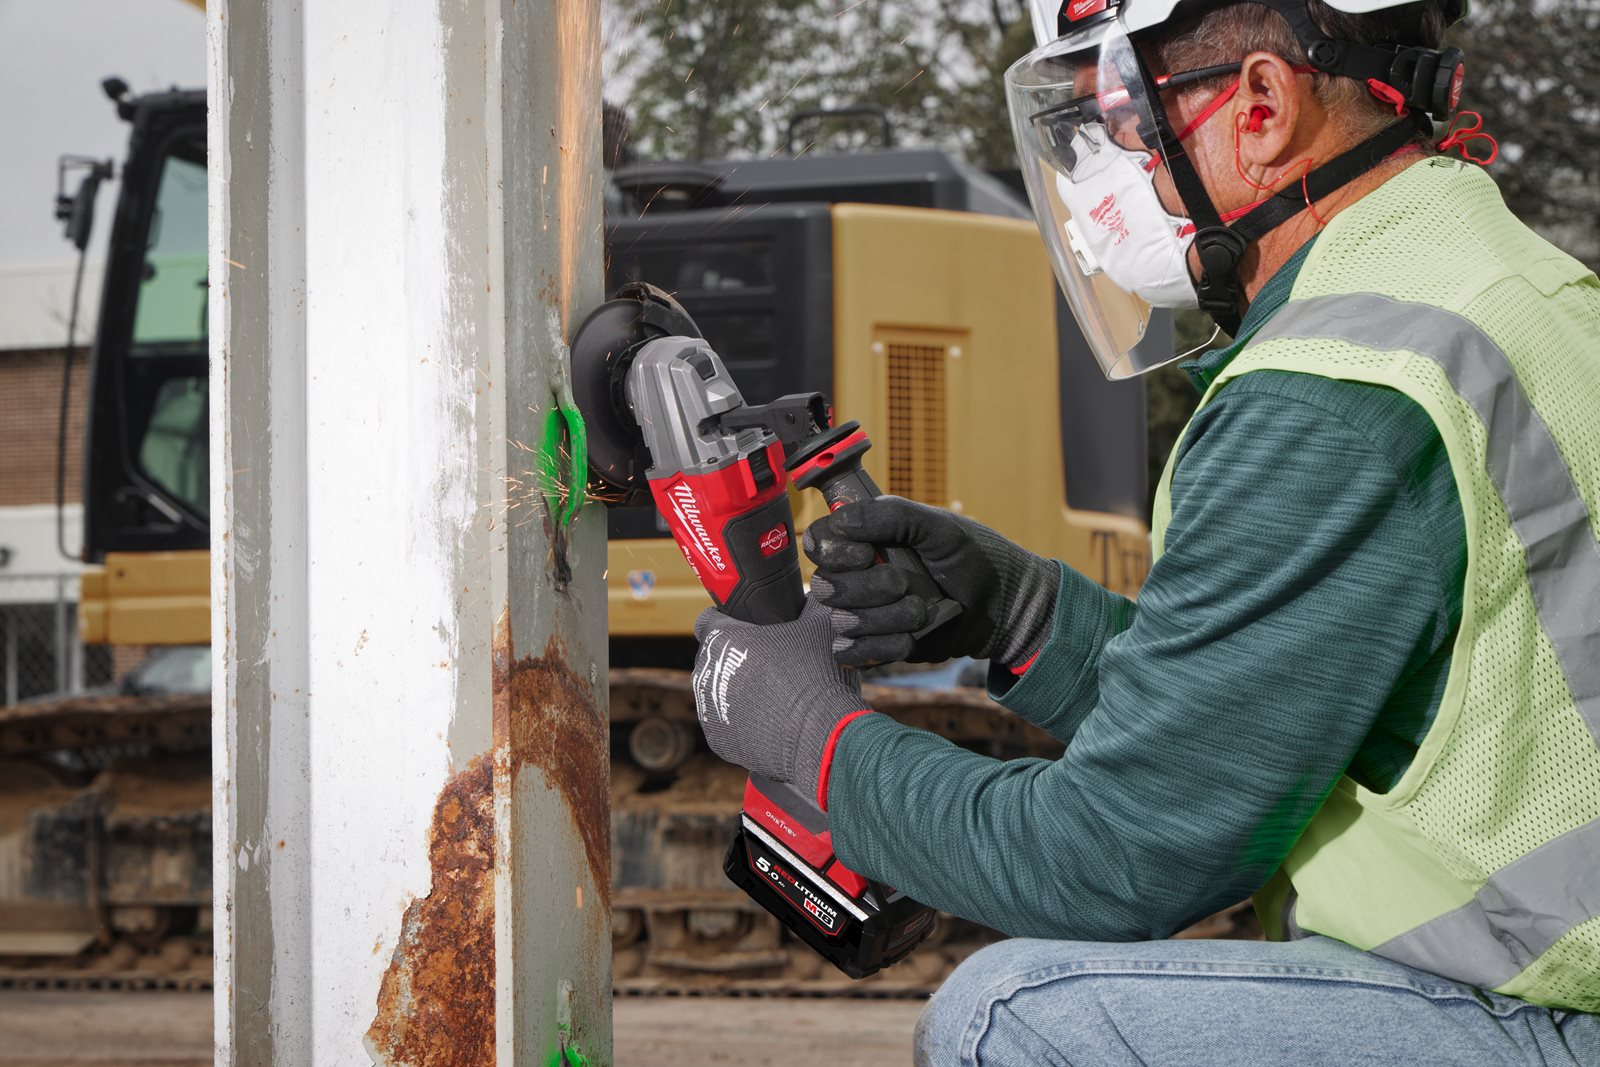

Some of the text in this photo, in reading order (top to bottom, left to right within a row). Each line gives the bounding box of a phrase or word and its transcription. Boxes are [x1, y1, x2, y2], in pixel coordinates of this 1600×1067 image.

[673, 481, 726, 571] Milwaukee
[755, 857, 779, 881] 5.0
[804, 897, 834, 928] M18
